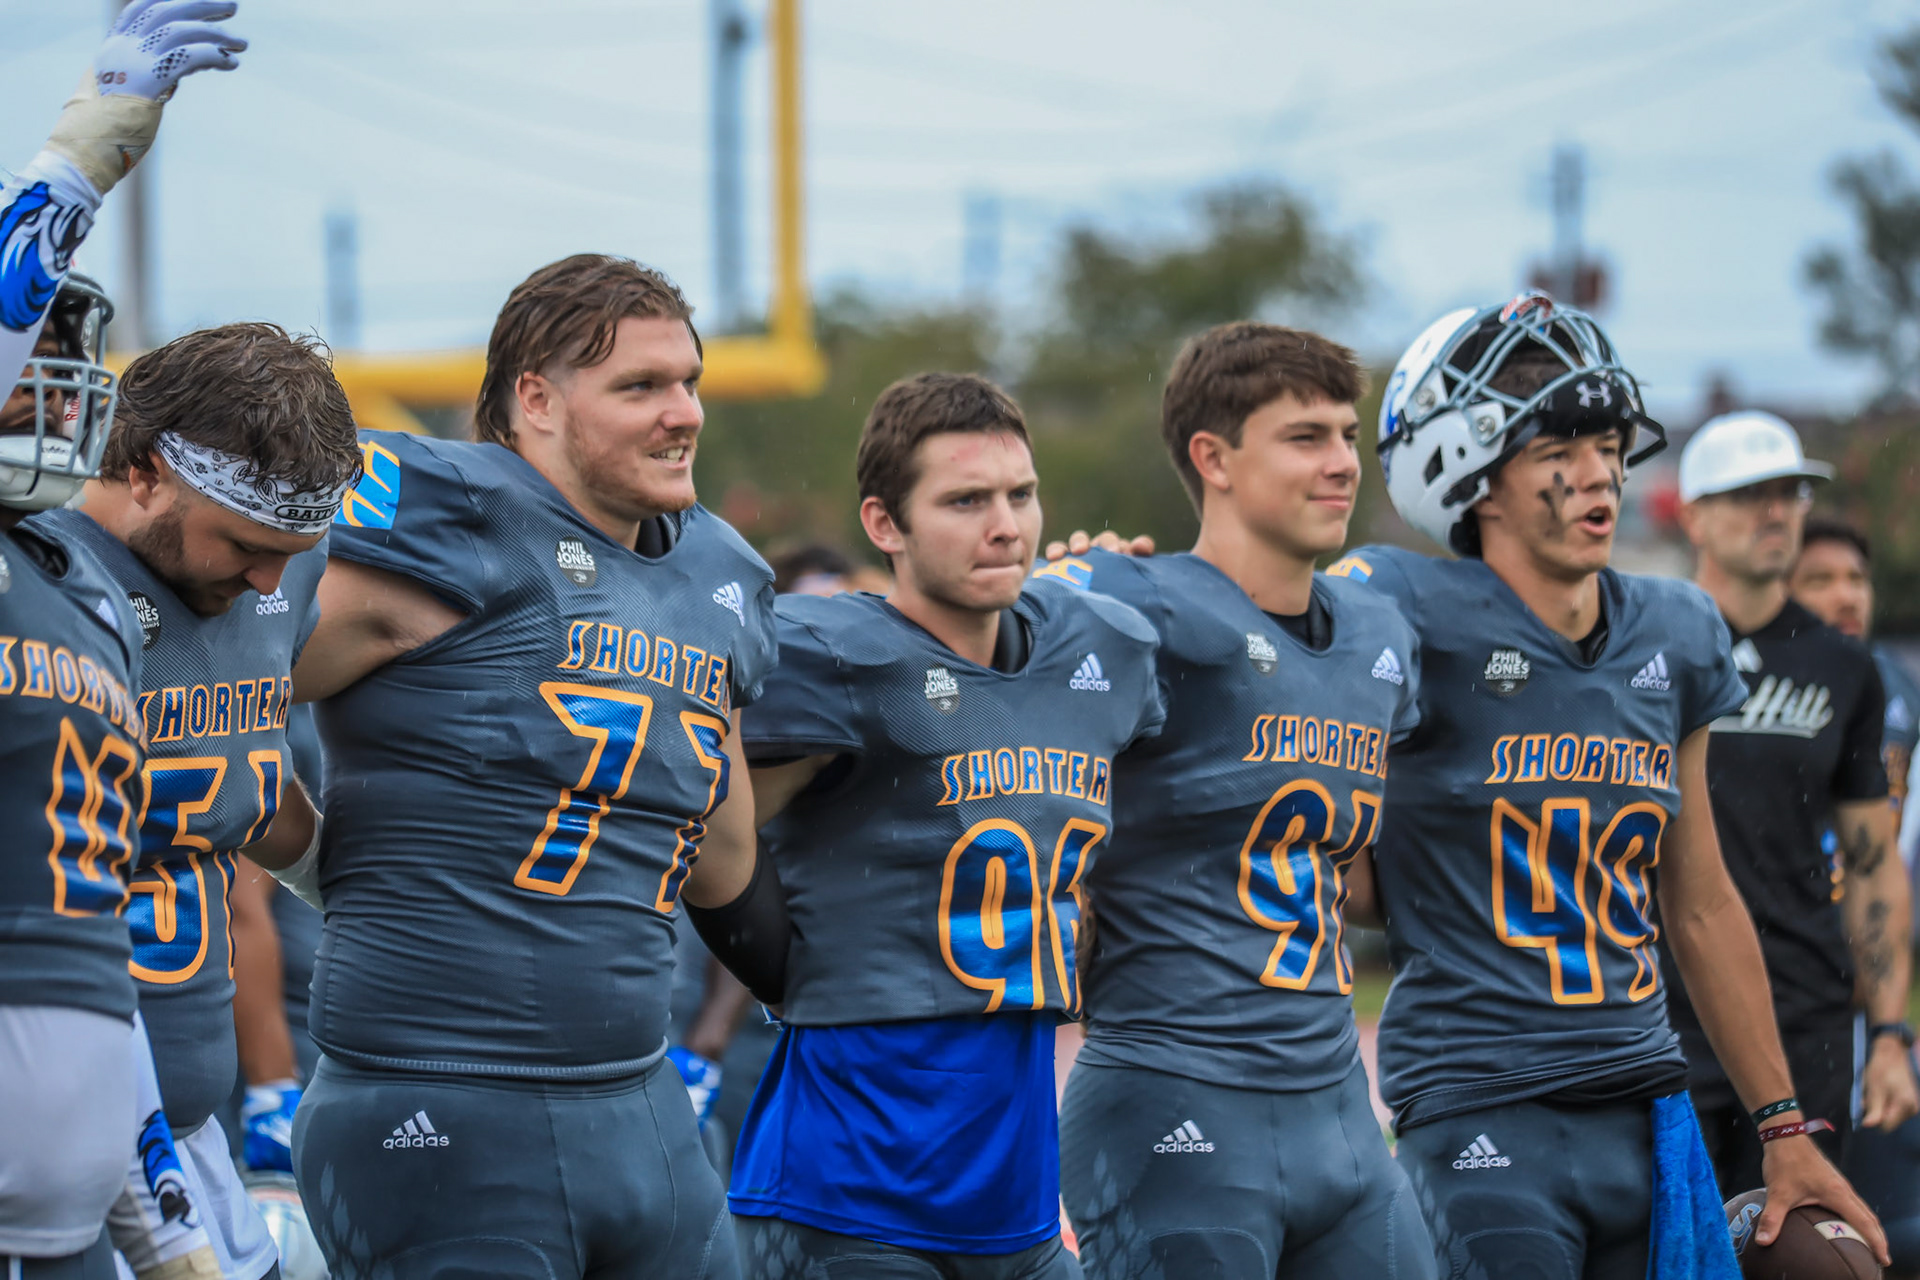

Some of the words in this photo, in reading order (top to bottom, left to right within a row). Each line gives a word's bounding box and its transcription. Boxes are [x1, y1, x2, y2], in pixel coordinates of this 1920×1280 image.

[559, 540, 586, 555] PHIL
[556, 551, 594, 567] JONES
[129, 597, 151, 610] HIL
[256, 599, 290, 616] adidas
[136, 607, 159, 623] NES
[1492, 650, 1523, 664] PHIL
[557, 620, 731, 718] SHORTE
[926, 668, 950, 682] PHIL
[1484, 660, 1530, 675] JONES
[924, 677, 958, 693] JONES
[1069, 676, 1111, 692] adidas
[1630, 675, 1671, 691] adidas
[1485, 733, 1673, 789] SHORTER
[936, 746, 1110, 806] SHORTER
[513, 681, 730, 914] 77
[1490, 797, 1668, 1005] 49
[383, 1132, 450, 1150] adidas
[1153, 1140, 1216, 1154] adidas
[1452, 1154, 1513, 1170] adidas
